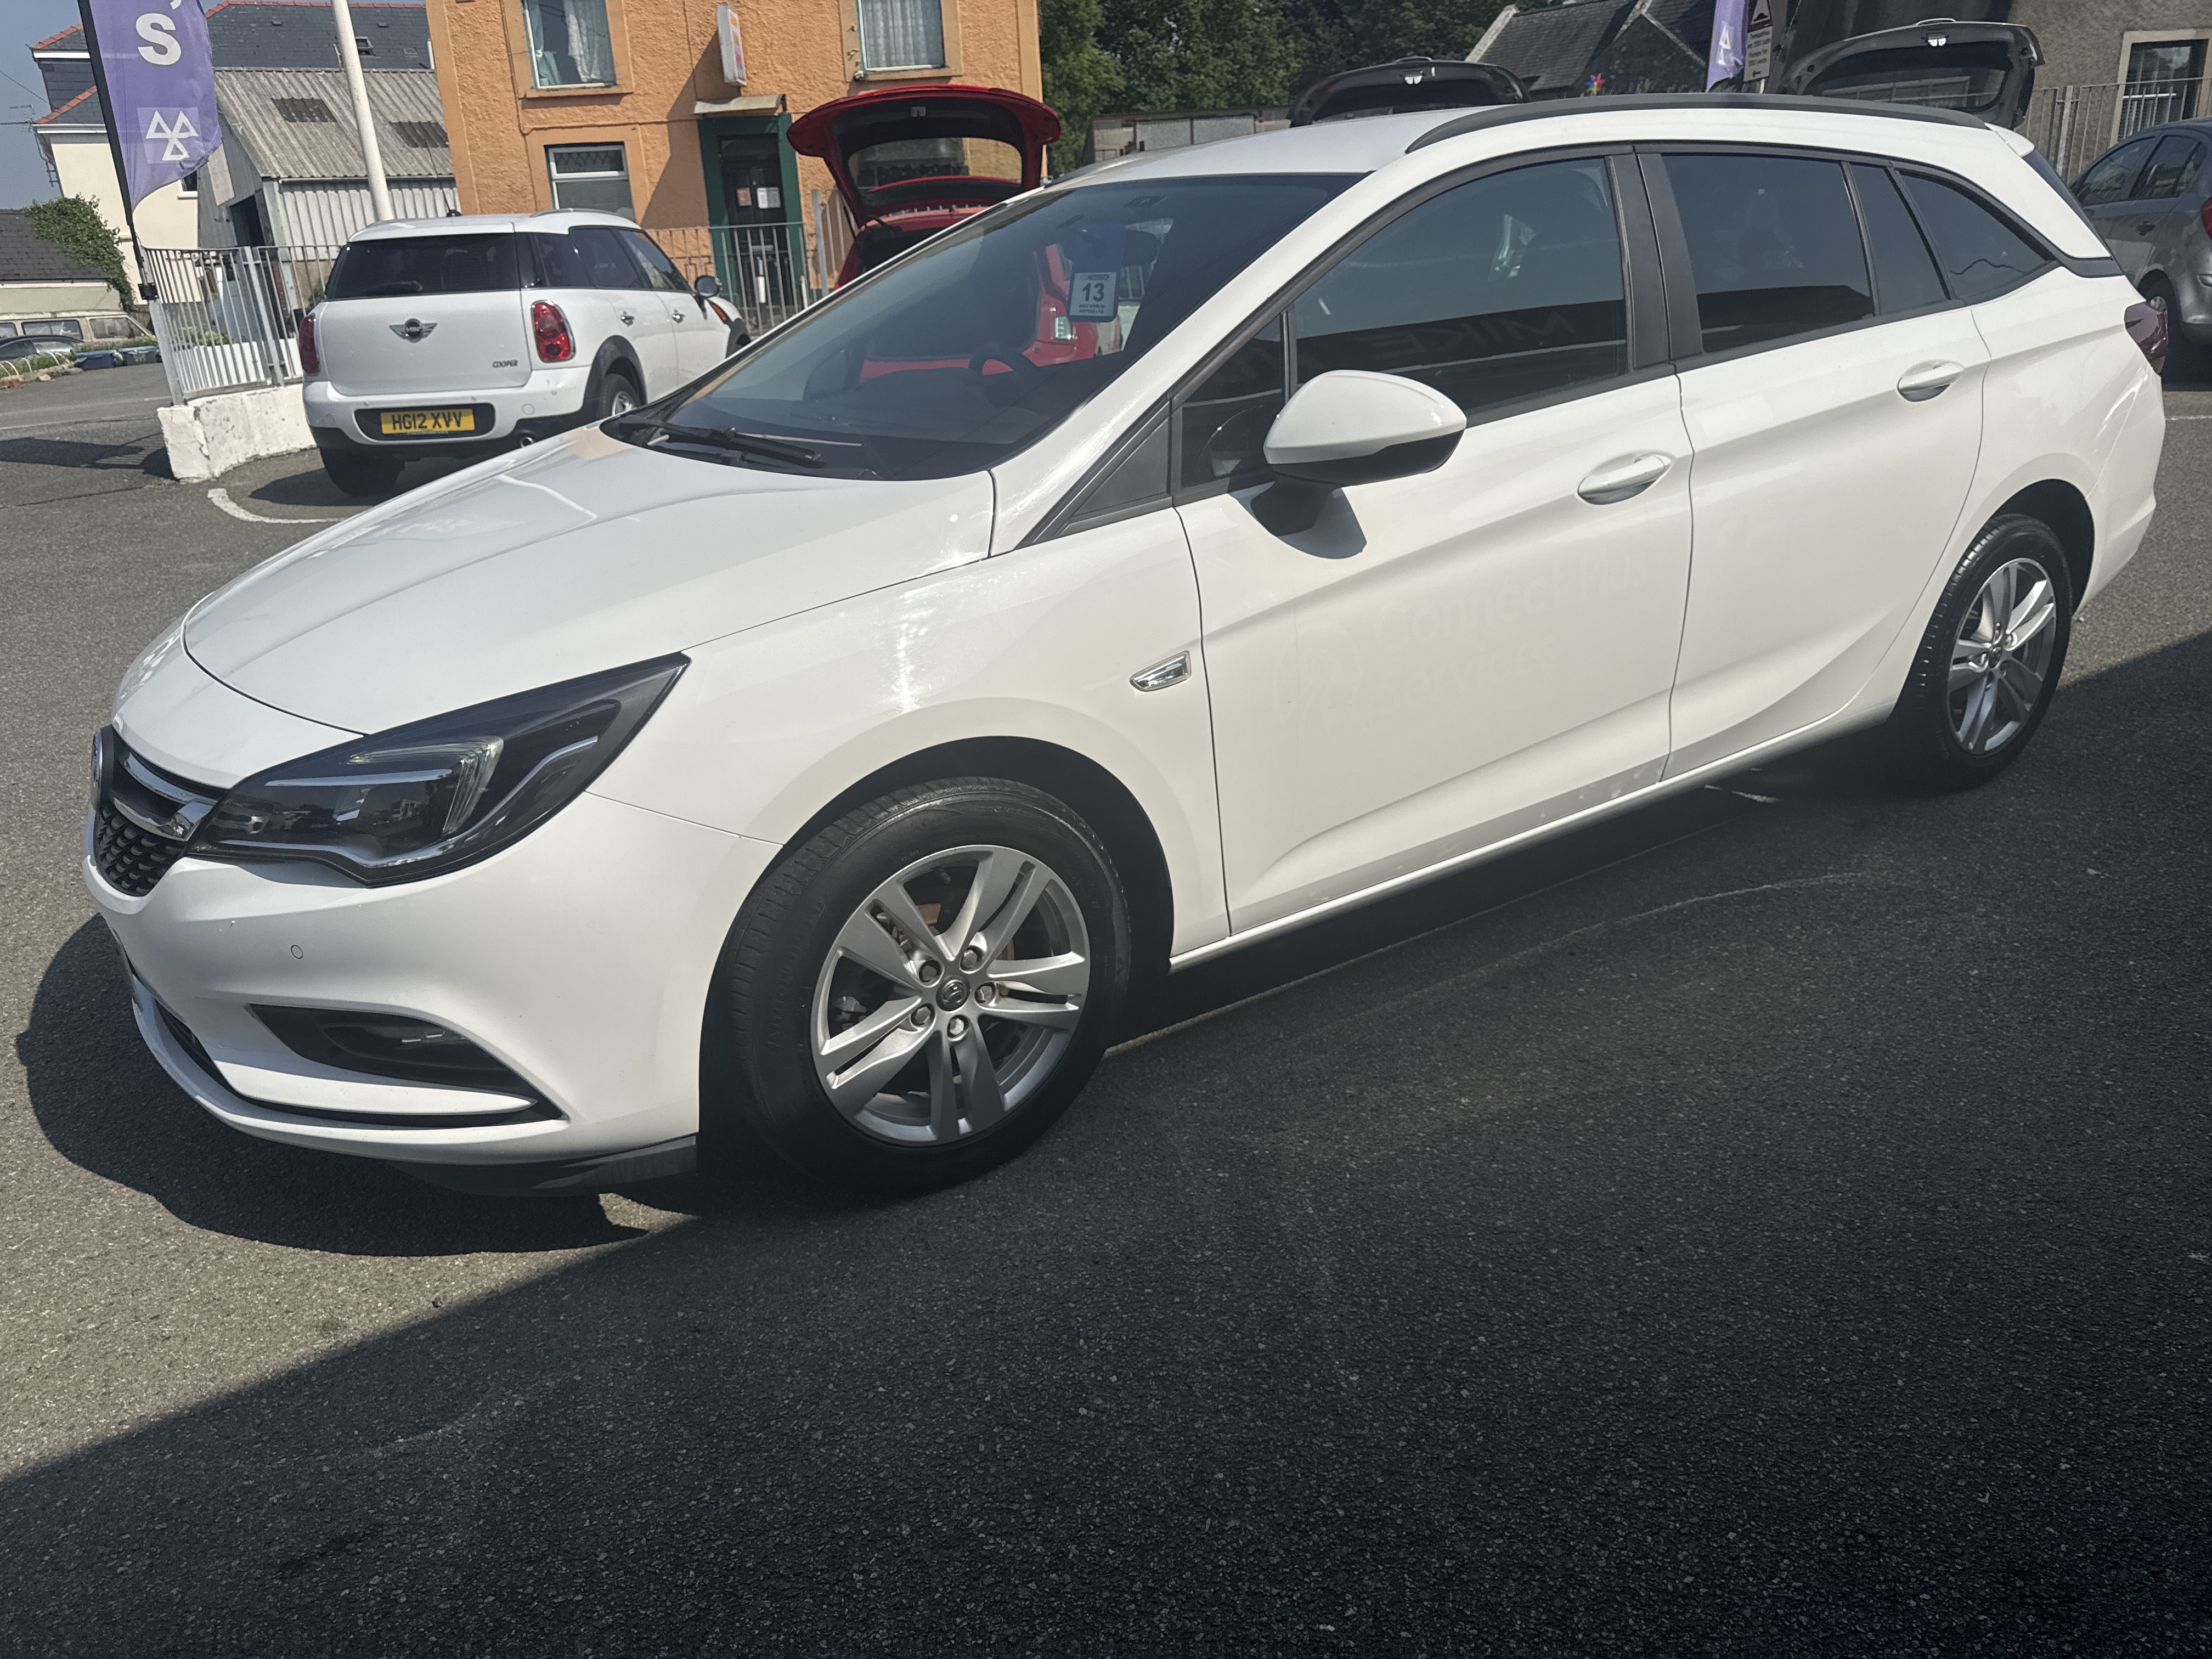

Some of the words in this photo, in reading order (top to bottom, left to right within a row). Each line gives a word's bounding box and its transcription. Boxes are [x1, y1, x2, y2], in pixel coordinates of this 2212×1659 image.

[1082, 283, 1105, 302] 13
[492, 359, 518, 368] COOPER
[392, 412, 427, 431] HG12
[430, 411, 462, 428] XVV
[1374, 558, 1565, 653] Connect
